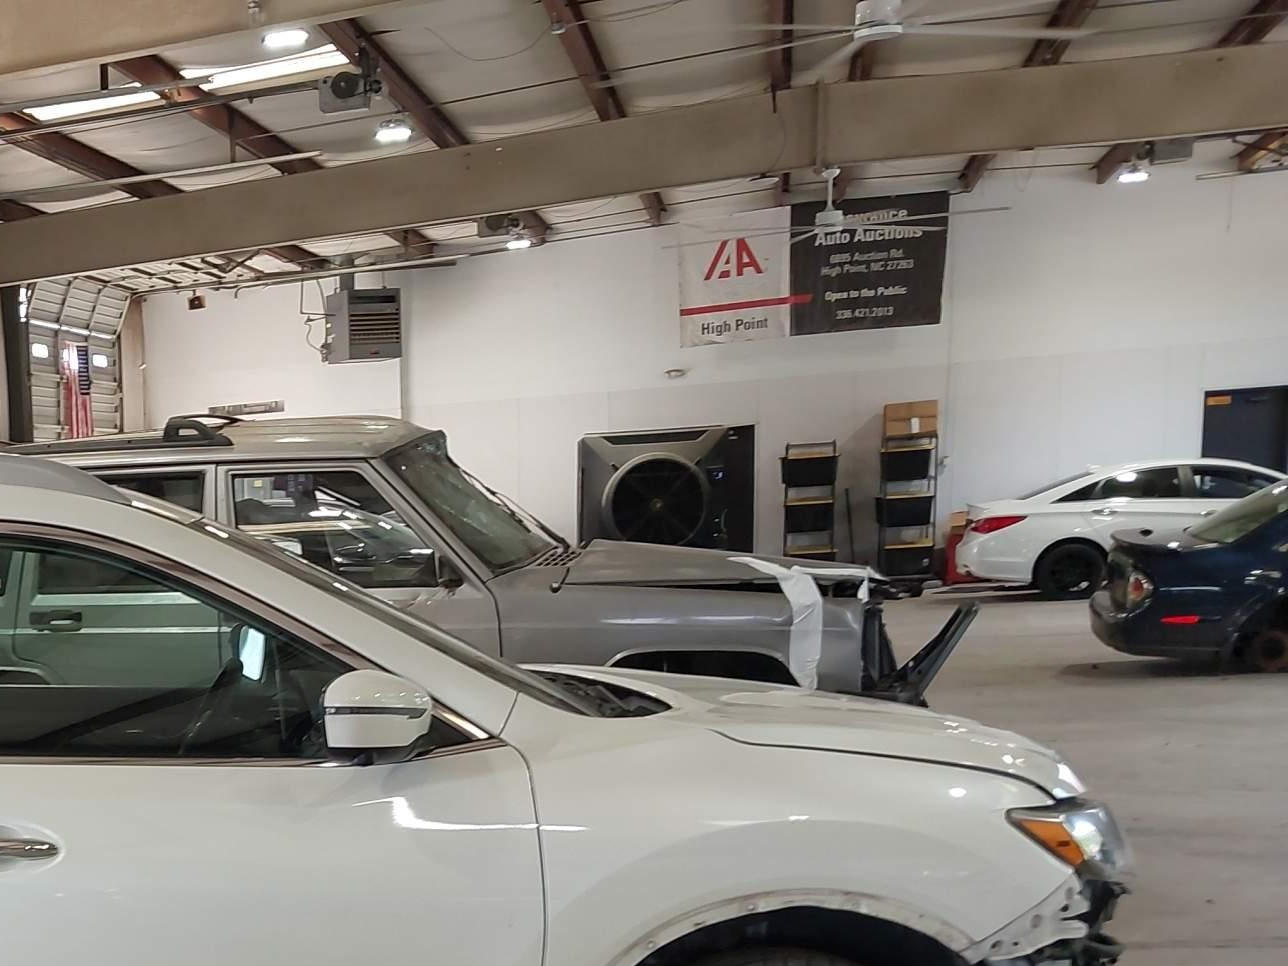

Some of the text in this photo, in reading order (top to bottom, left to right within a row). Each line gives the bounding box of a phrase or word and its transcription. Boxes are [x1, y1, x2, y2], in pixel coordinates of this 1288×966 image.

[814, 226, 922, 247] Auto Auctions
[852, 251, 889, 262] Auction
[820, 265, 842, 277] High
[870, 260, 886, 271] NC
[824, 285, 908, 302] Open to the Public
[701, 316, 769, 337] High Point
